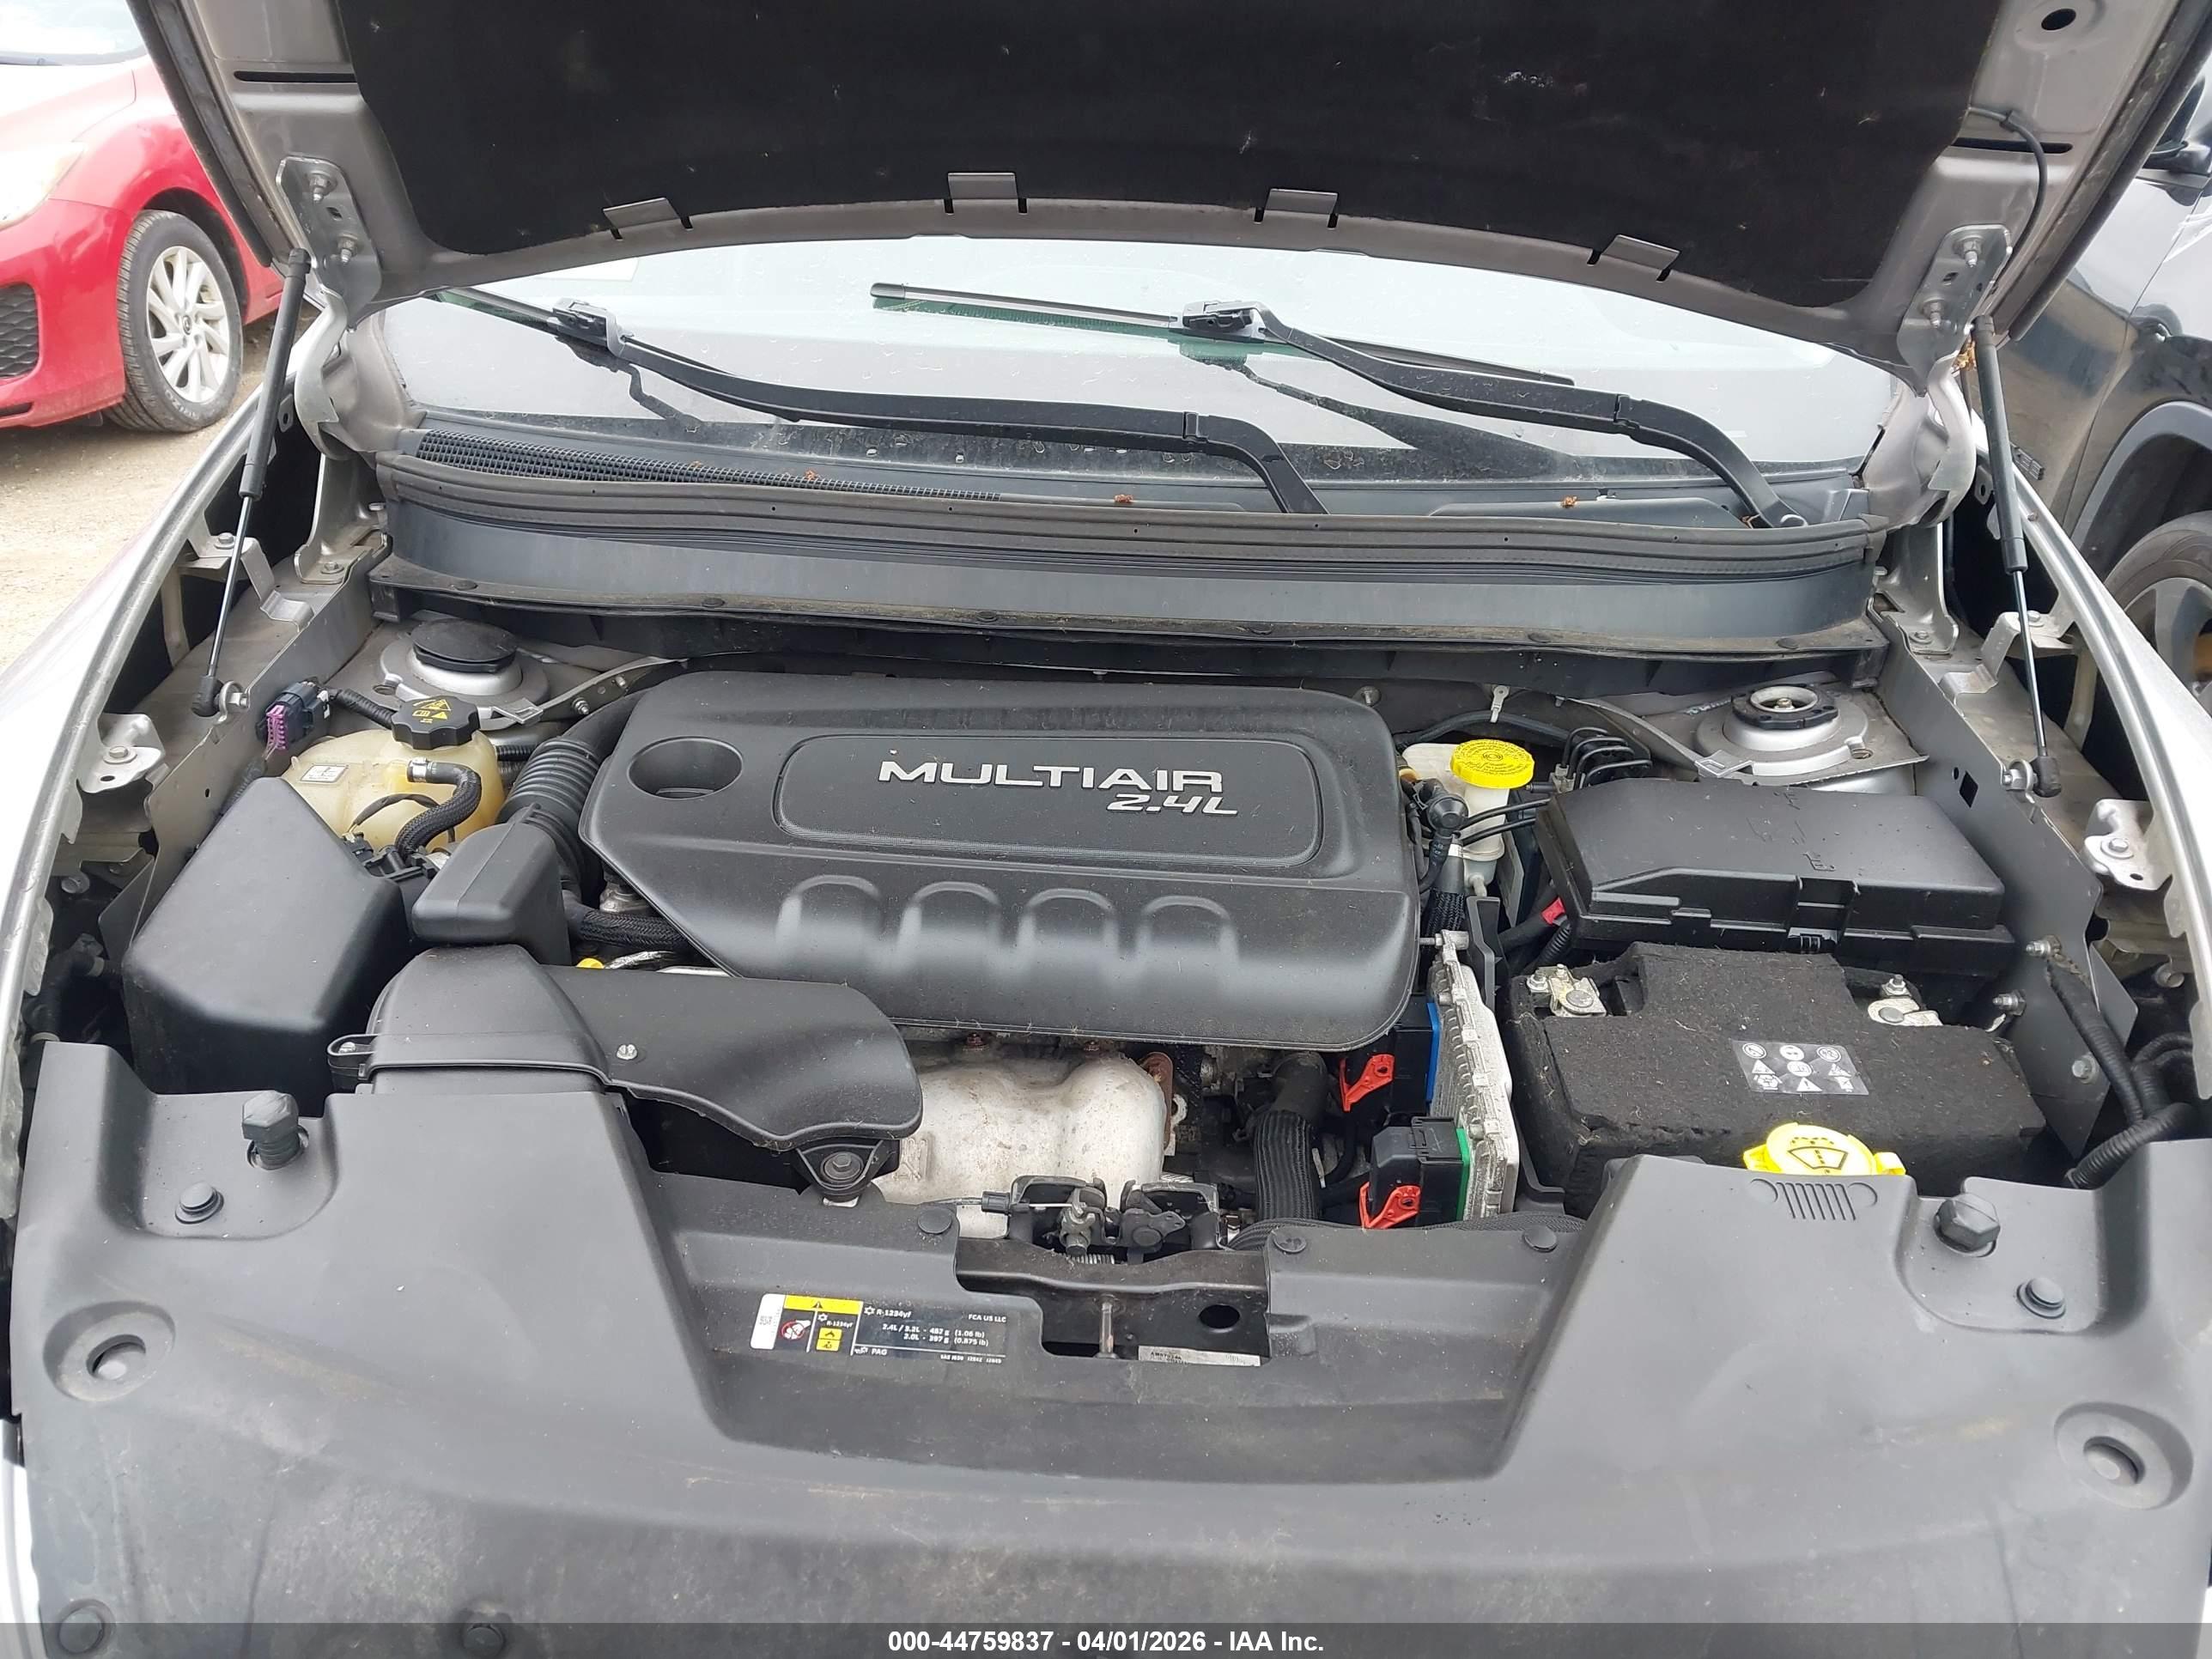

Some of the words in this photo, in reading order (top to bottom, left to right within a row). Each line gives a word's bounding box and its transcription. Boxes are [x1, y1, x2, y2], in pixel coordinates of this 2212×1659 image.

[878, 761, 1223, 793] MULTIAIR
[1107, 793, 1237, 815] 2.4L
[876, 1309, 912, 1319] R-1234yf
